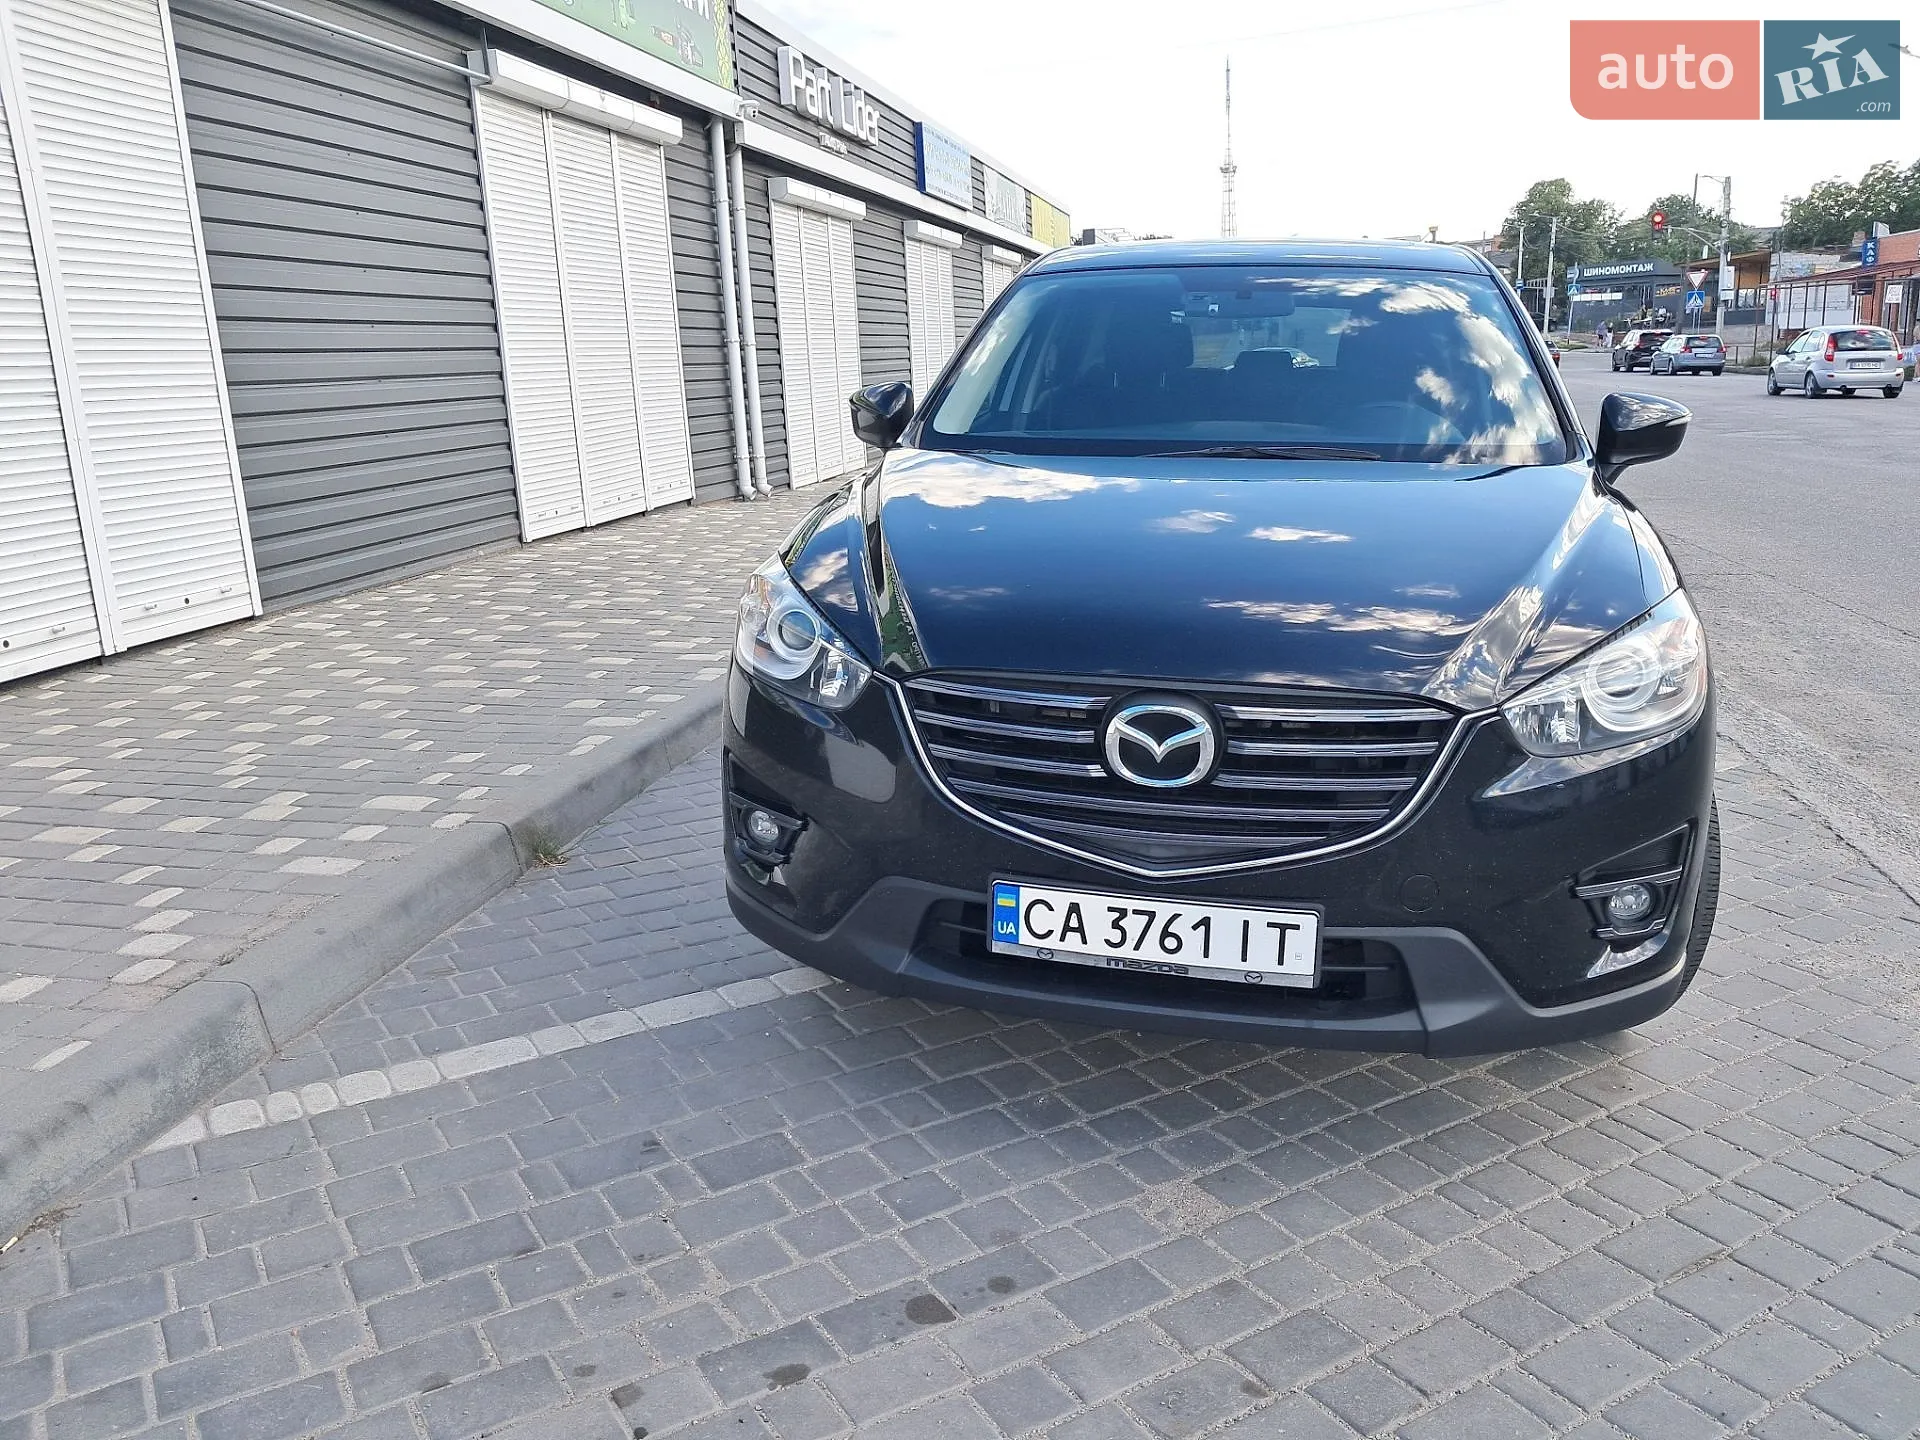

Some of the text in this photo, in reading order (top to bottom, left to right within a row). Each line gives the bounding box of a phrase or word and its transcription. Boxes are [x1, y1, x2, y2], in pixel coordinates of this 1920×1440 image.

[778, 46, 834, 129] Part
[832, 77, 880, 146] Lider
[1866, 242, 1876, 266] КАФ
[1583, 262, 1654, 277] ШИНОМОНТАЖ
[997, 921, 1017, 935] UA
[1024, 898, 1301, 966] CA 3761 IT
